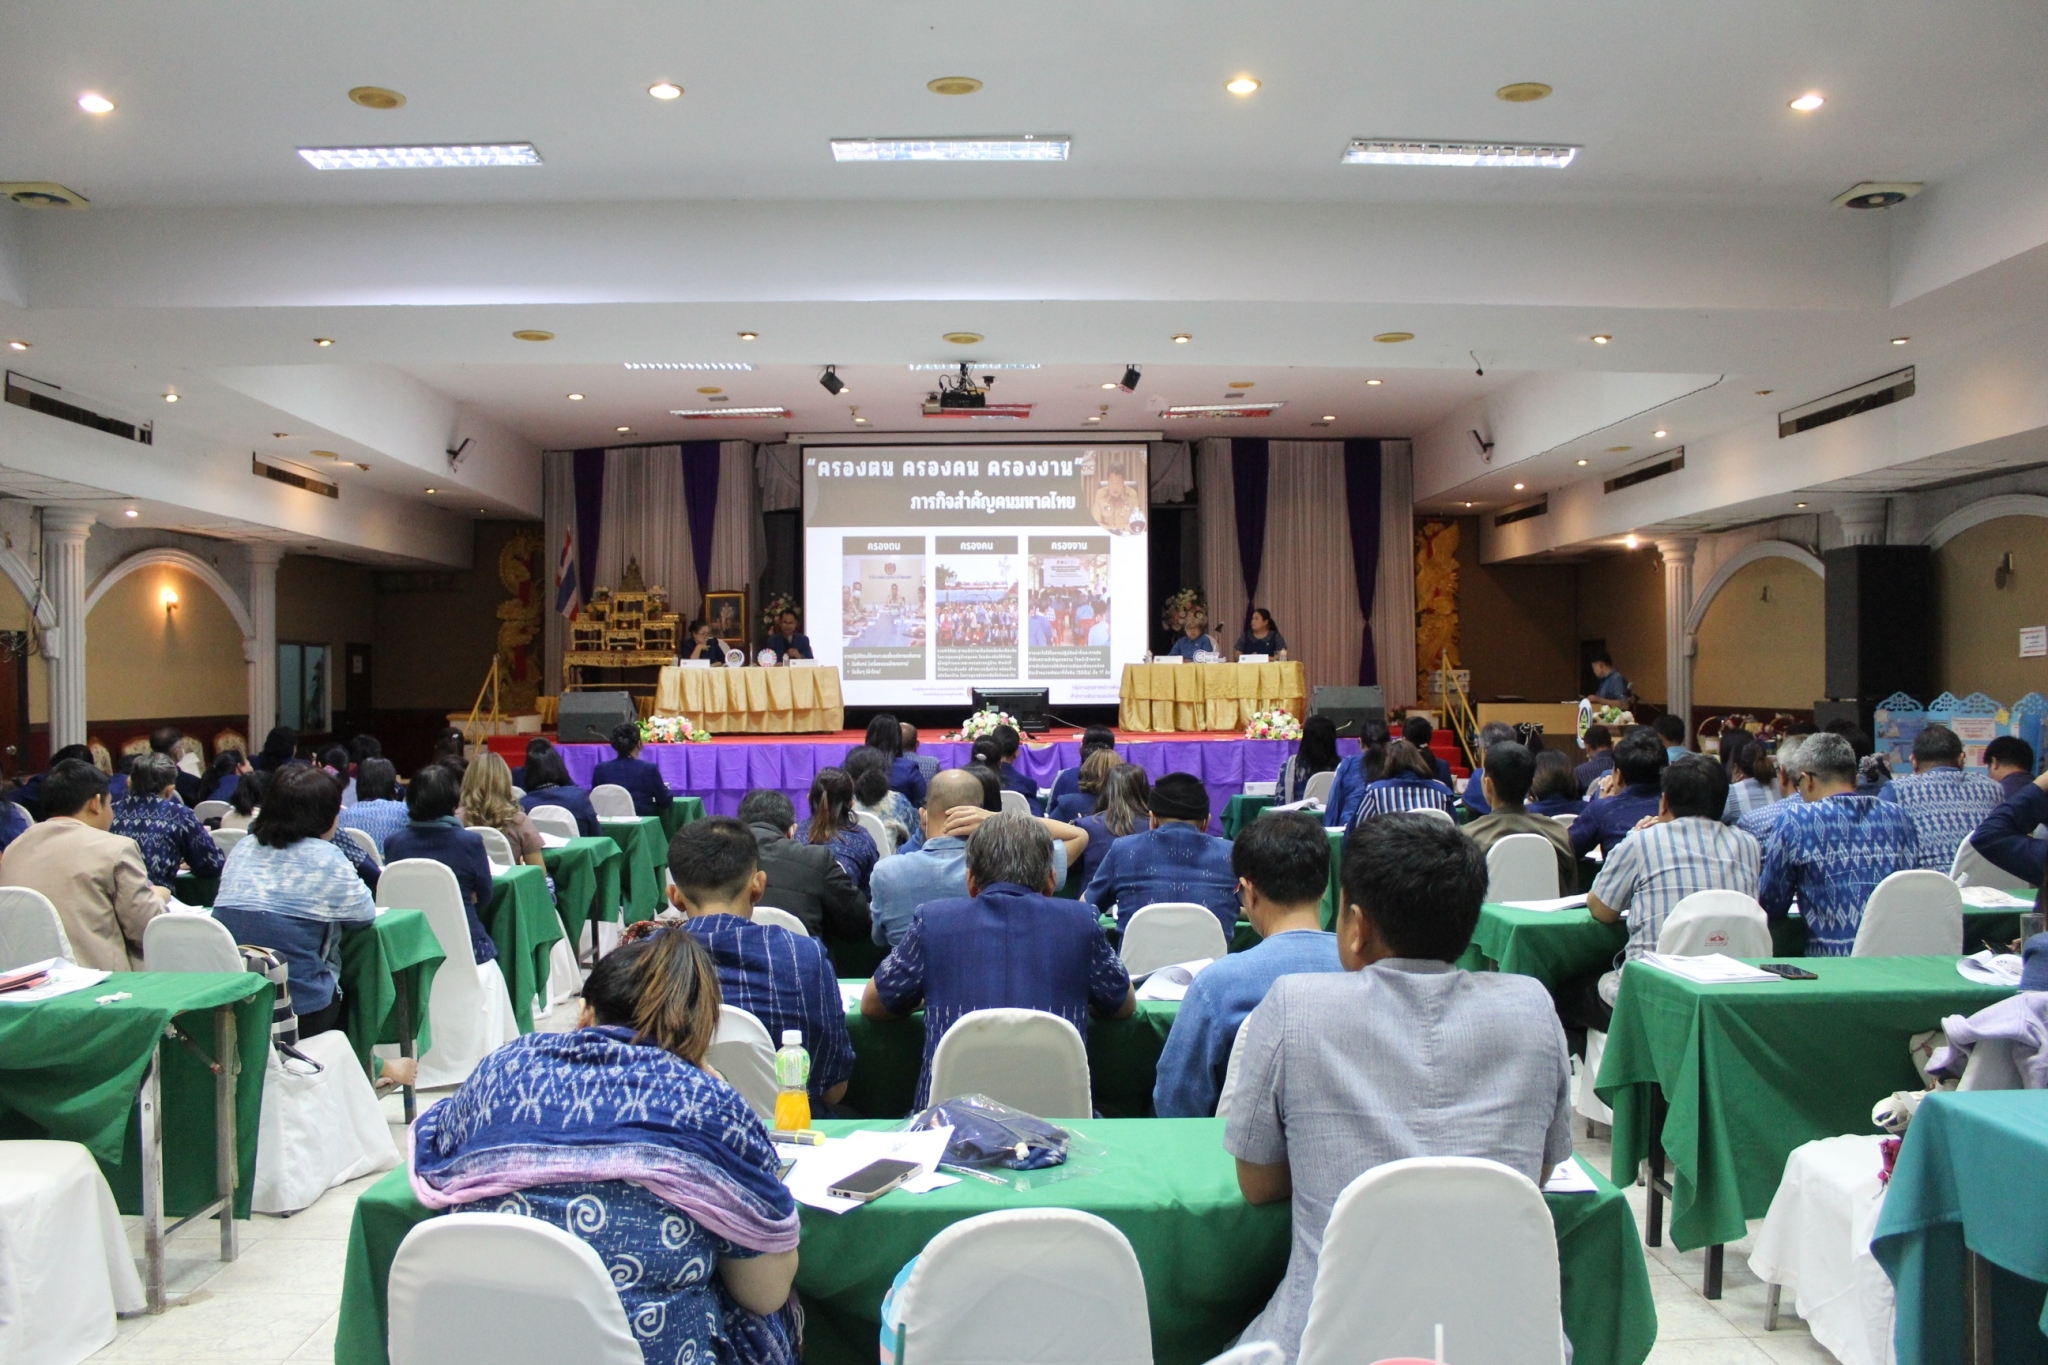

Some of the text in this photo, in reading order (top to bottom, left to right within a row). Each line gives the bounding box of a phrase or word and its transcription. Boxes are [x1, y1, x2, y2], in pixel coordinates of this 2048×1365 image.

[902, 460, 979, 477] ครองคน
[910, 490, 1076, 514] ภารกิจสำคัญคนมหาดไทย
[867, 541, 901, 551] ครองตน
[960, 541, 993, 551] ครองคน
[1051, 541, 1088, 551] ครองงาน
